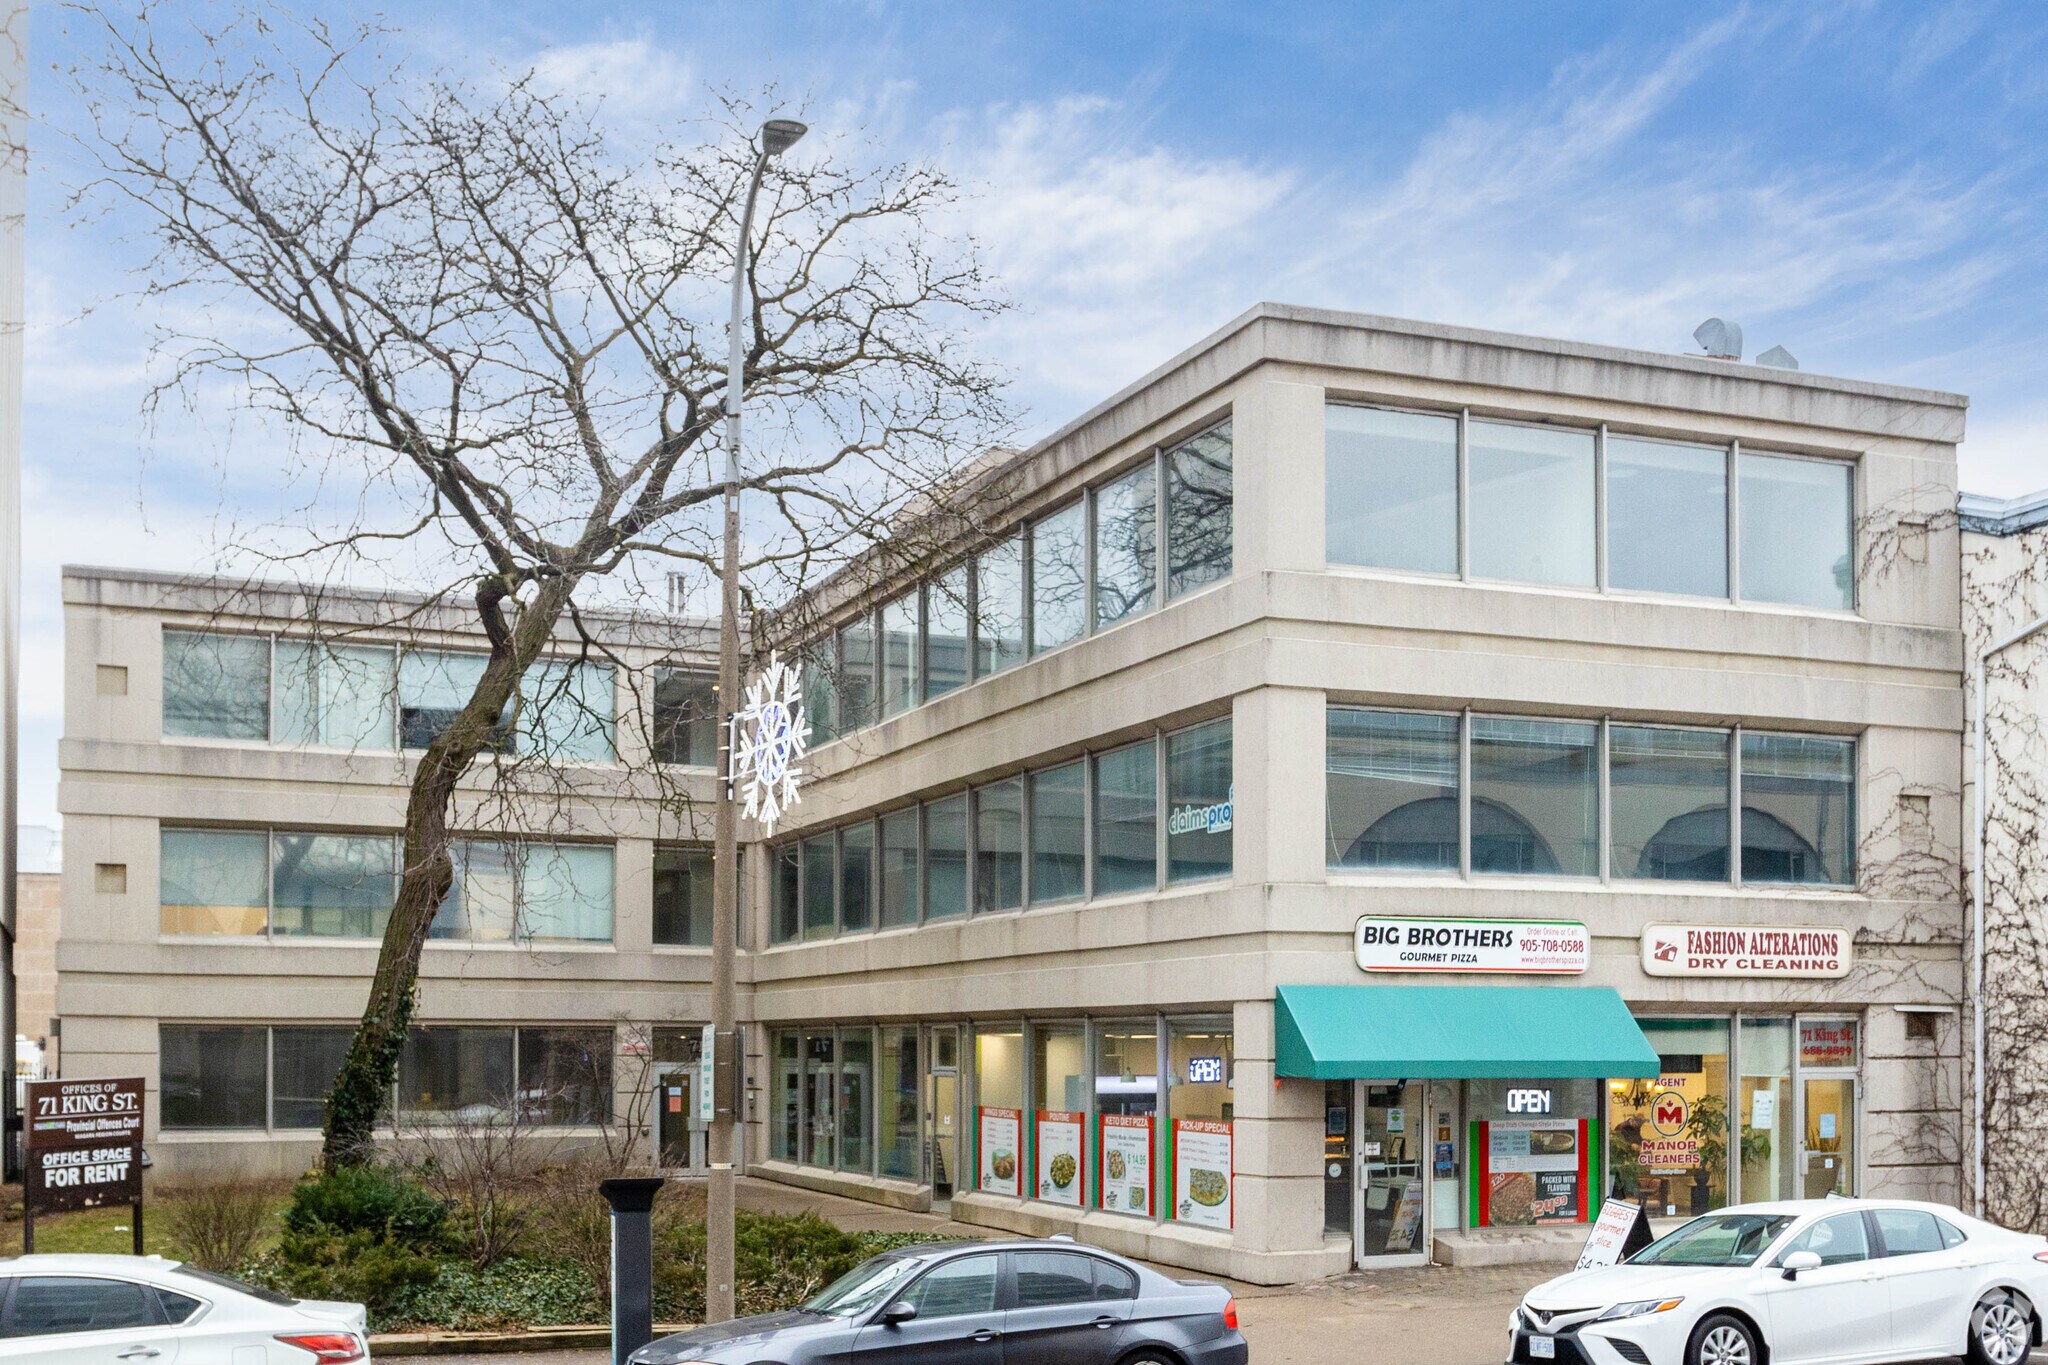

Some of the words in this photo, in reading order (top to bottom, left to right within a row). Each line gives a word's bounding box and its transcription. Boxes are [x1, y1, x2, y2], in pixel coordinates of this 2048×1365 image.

[1169, 803, 1232, 834] claimspro
[1363, 926, 1400, 945] BIG
[1407, 928, 1513, 948] BROTHERS
[1526, 927, 1541, 936] Order
[1543, 928, 1559, 936] Online
[1519, 939, 1584, 953] 905-708-0588
[1687, 931, 1746, 955] FASHION
[1750, 932, 1839, 956] ALTERATIONS
[1400, 952, 1447, 962] GOURMET
[1451, 954, 1478, 964] PIZZA
[1521, 956, 1585, 965] www.bigbrotherspizza.ca
[1688, 958, 1729, 969] DRY
[1736, 959, 1839, 970] CLEANING
[1801, 1029, 1812, 1043] 71
[1815, 1027, 1838, 1044] King
[61, 1084, 101, 1094] OFFICES
[104, 1083, 117, 1092] OF
[1655, 1078, 1687, 1087] AGENT
[38, 1097, 57, 1115] 71
[61, 1095, 108, 1113] KING
[112, 1092, 138, 1110] ST.
[1507, 1089, 1550, 1112] OPEN
[1049, 1113, 1069, 1121] POUTINE
[1105, 1116, 1119, 1125] KETO
[1120, 1117, 1132, 1126] DIET
[1133, 1118, 1149, 1127] PIZZA
[1658, 1106, 1682, 1124] M
[66, 1120, 96, 1132] Provincial
[97, 1118, 122, 1130] Offences
[123, 1117, 139, 1128] Court
[1180, 1120, 1203, 1131] PICK-UP
[1204, 1123, 1230, 1134] SPECIAL
[1642, 1141, 1697, 1150] MANOR
[42, 1151, 88, 1165] OFFICE
[92, 1148, 131, 1161] SPACE
[1639, 1154, 1700, 1164] CLEANERS
[45, 1168, 80, 1188] FOR
[84, 1163, 129, 1184] RENT
[1542, 1176, 1562, 1184] PACKED
[1563, 1175, 1576, 1183] WITH
[1547, 1184, 1570, 1192] FLAVOUR
[1602, 1204, 1636, 1222] BIGGEST
[1595, 1222, 1625, 1236] gourmet
[1595, 1236, 1612, 1248] slice
